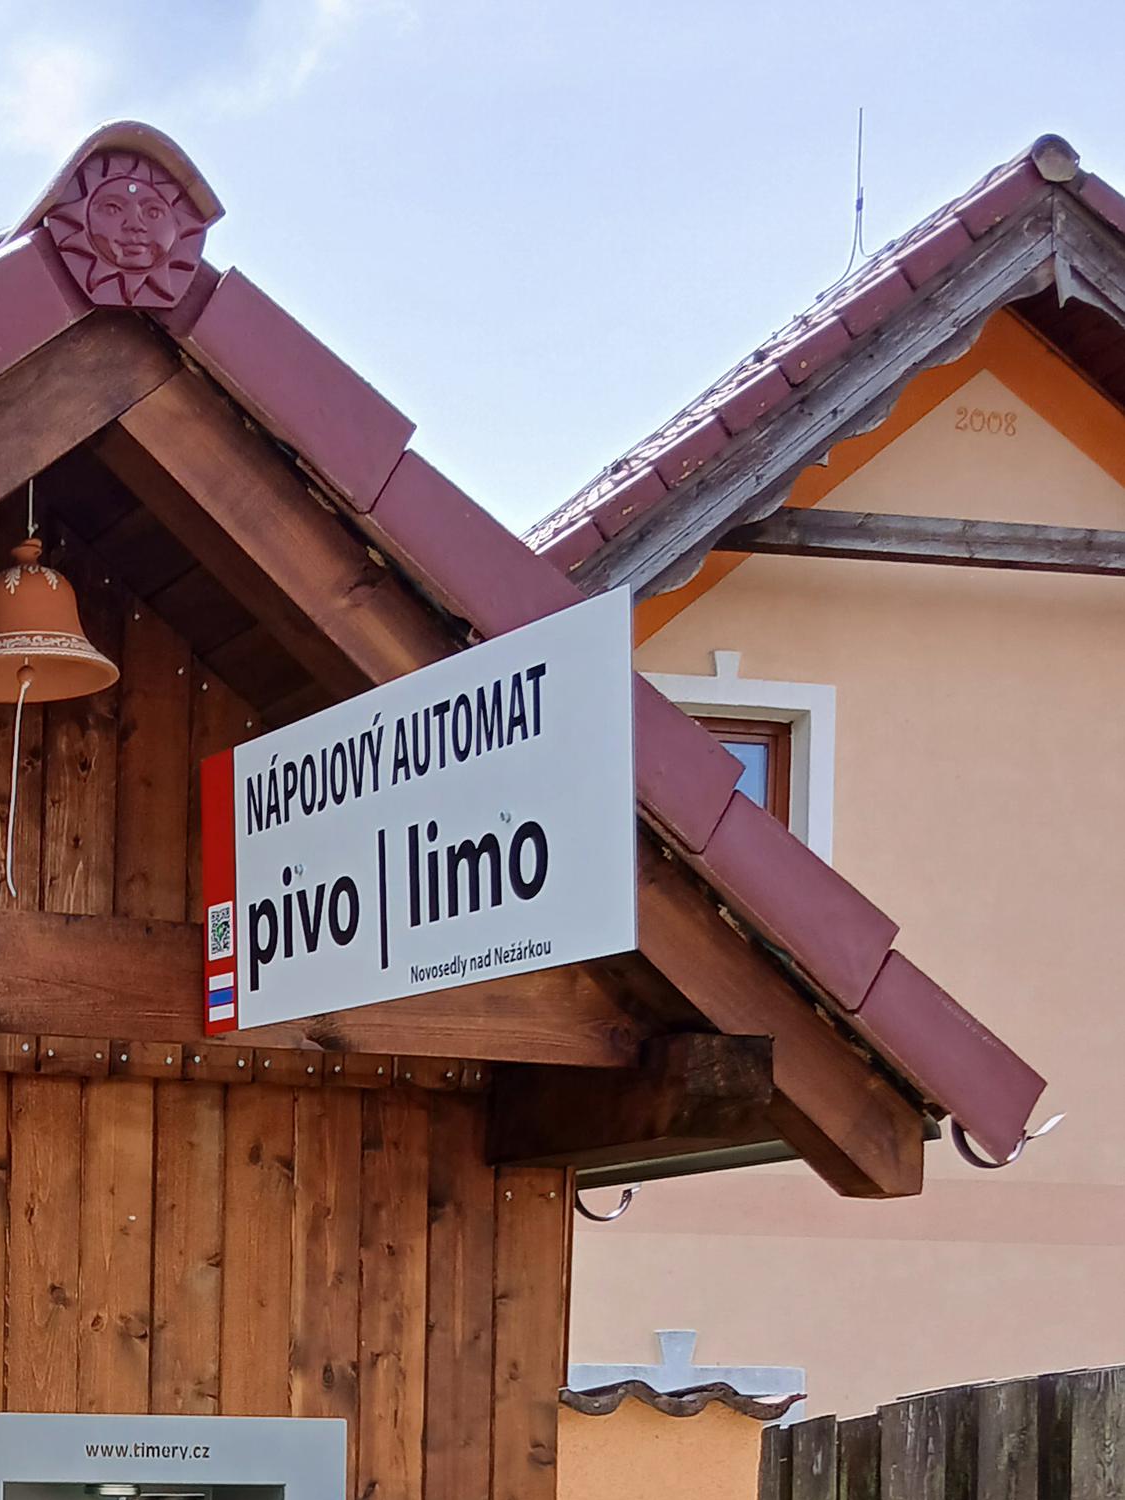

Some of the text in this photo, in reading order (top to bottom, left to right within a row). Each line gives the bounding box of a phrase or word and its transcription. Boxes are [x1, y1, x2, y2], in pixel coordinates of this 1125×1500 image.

[955, 406, 1017, 437] 2008
[246, 663, 546, 835] NÁPOJOVÝ AUTOMAT
[248, 820, 549, 992] pivo limo
[410, 939, 552, 984] Novosedly nad Nežárkou
[85, 1442, 211, 1460] www.timery.cz
